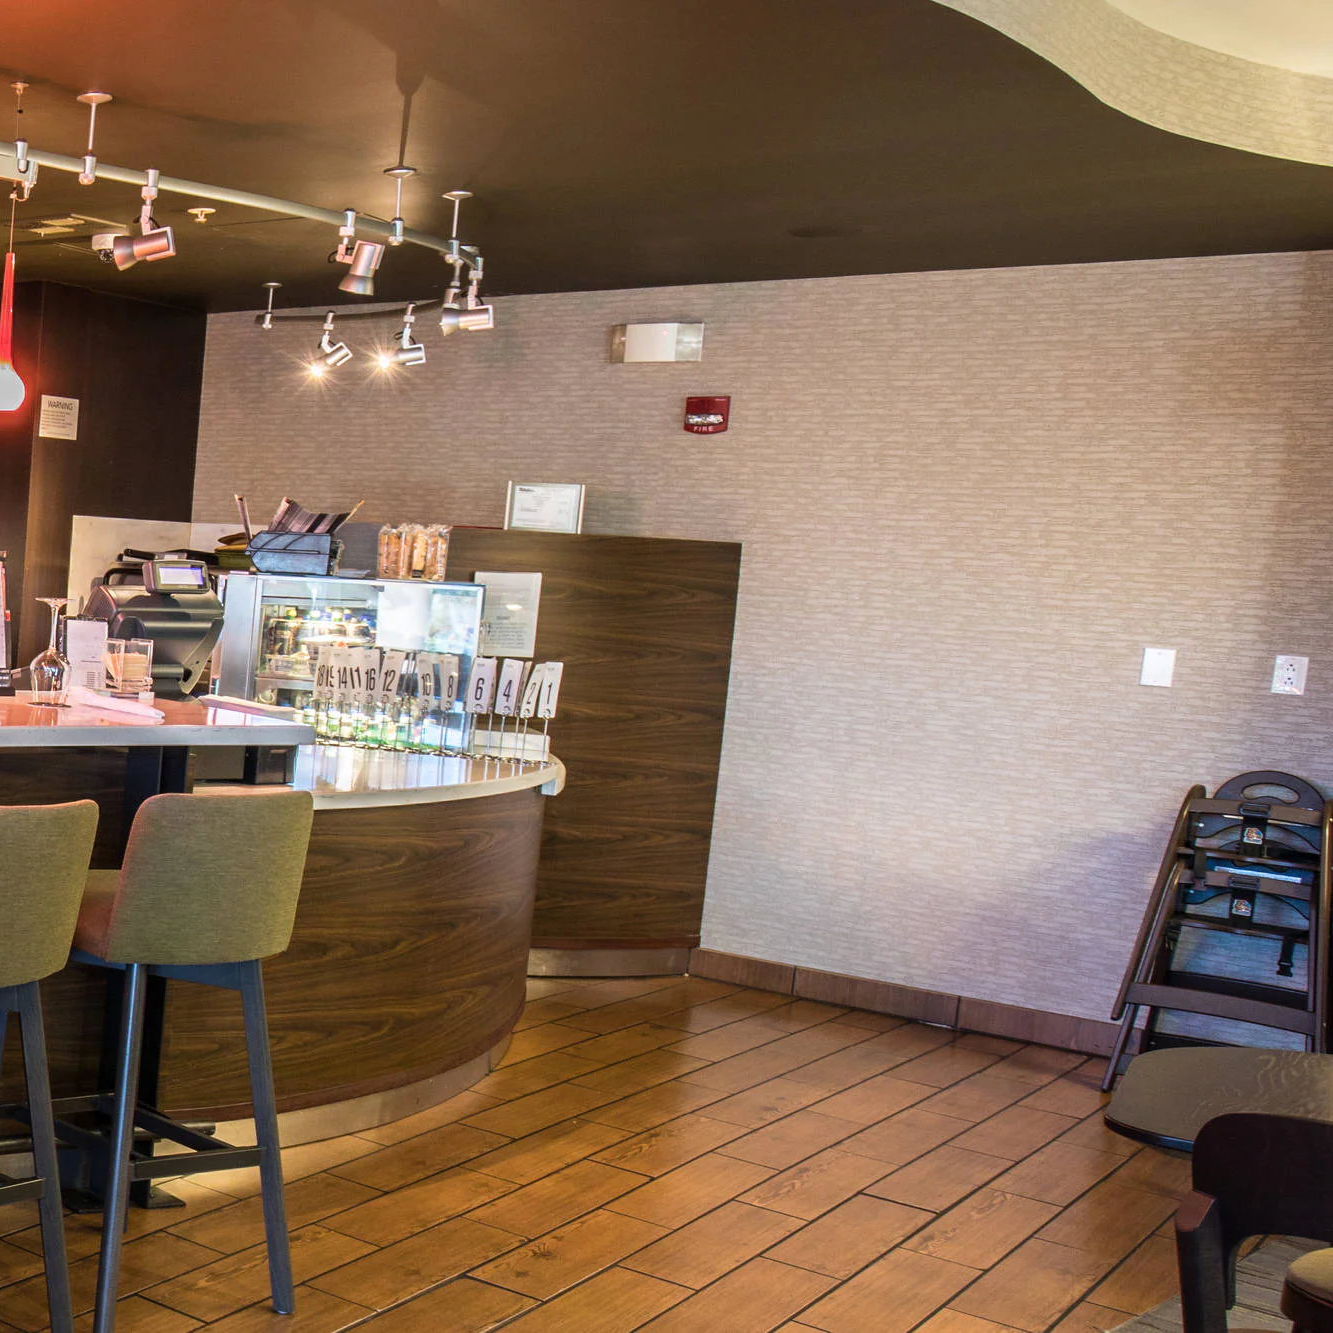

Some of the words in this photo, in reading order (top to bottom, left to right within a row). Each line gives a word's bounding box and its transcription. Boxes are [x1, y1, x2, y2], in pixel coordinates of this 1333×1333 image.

[47, 400, 74, 411] WARNING
[337, 666, 348, 689] 14
[365, 667, 376, 691] 16
[382, 669, 396, 692] 12
[421, 673, 432, 697] 10
[447, 675, 454, 698] 8
[474, 677, 485, 701] 6
[502, 679, 513, 702] 4
[526, 682, 537, 705] 2
[547, 682, 553, 705] 1
